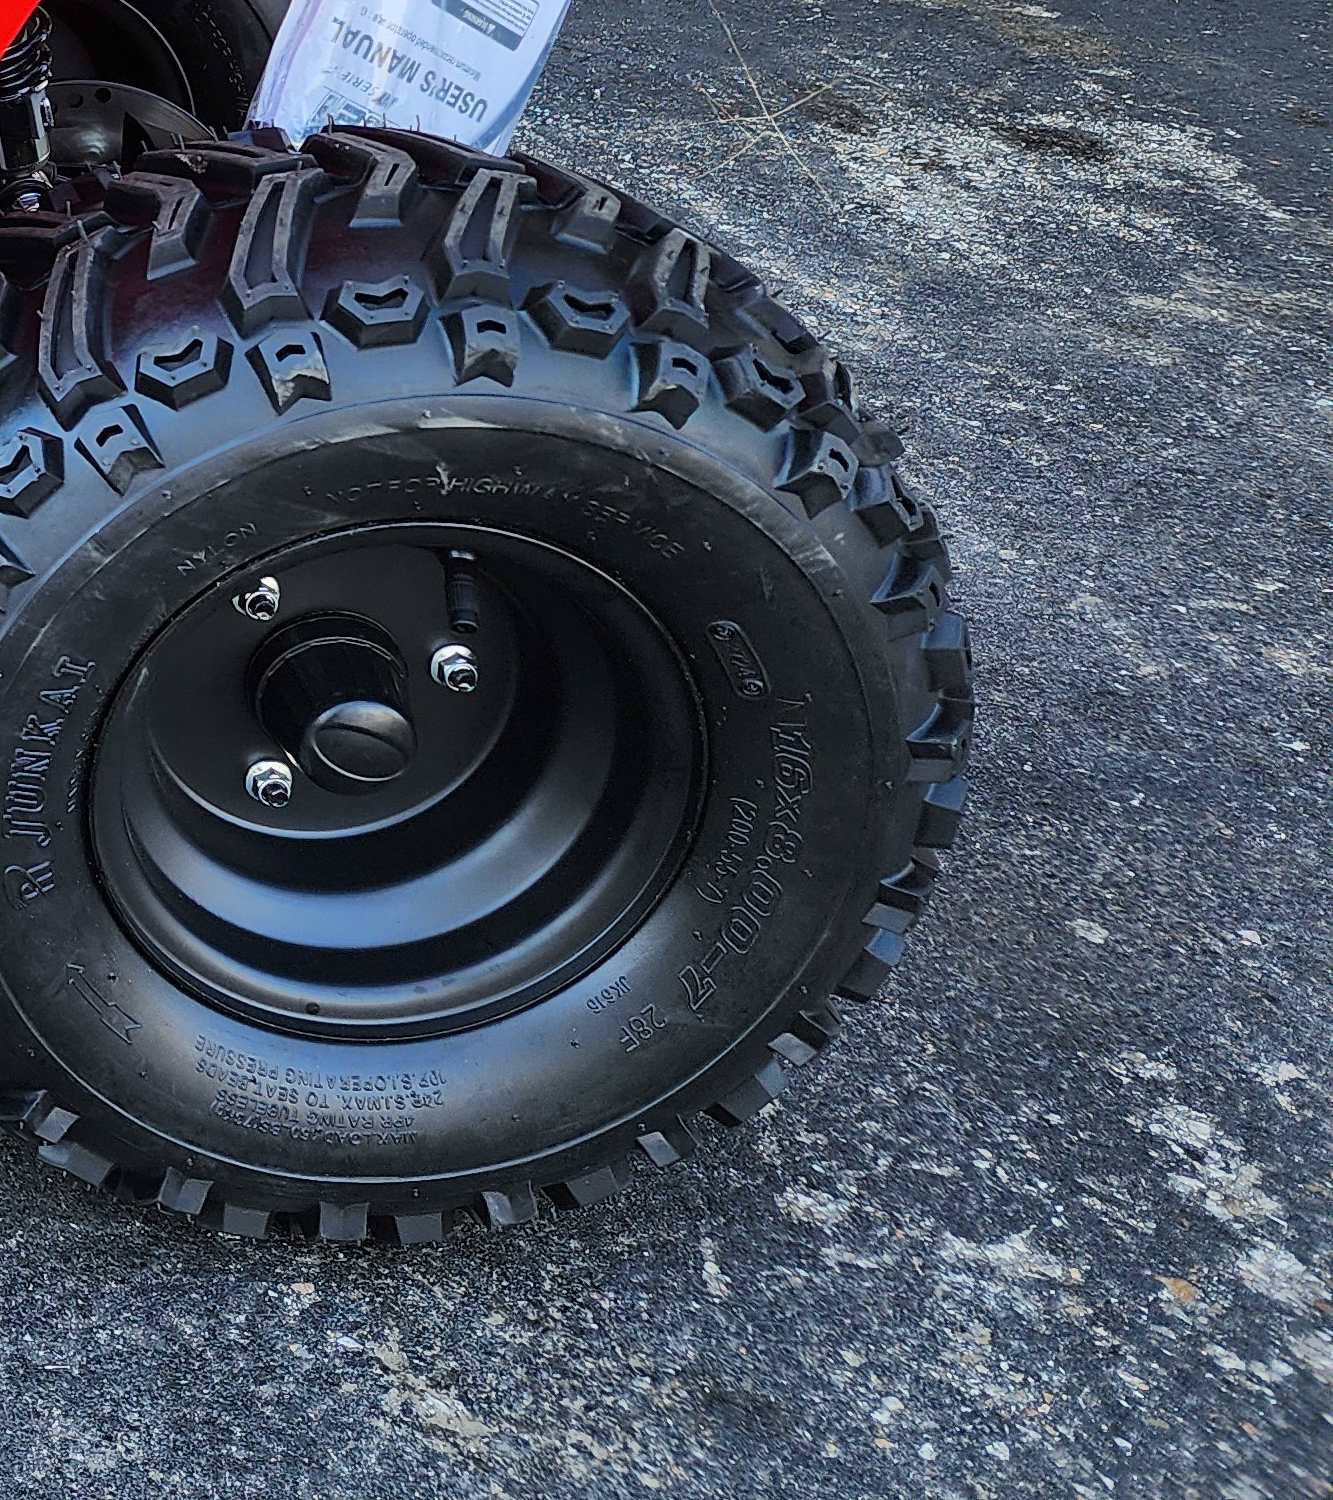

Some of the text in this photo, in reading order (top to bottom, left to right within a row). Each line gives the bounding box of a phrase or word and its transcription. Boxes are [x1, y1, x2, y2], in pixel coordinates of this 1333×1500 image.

[386, 20, 417, 43] operator
[324, 15, 422, 84] MANUAL
[417, 67, 487, 124] USER'S
[2, 652, 96, 847] JUNKAI
[618, 1001, 667, 1054] 28F
[193, 1034, 278, 1080] PRESSURE
[194, 1058, 253, 1092] BEADS
[254, 1081, 299, 1103] SEAT
[214, 1087, 299, 1121] TUBELESS
[304, 1091, 329, 1108] TO
[305, 1110, 373, 1129] RATING
